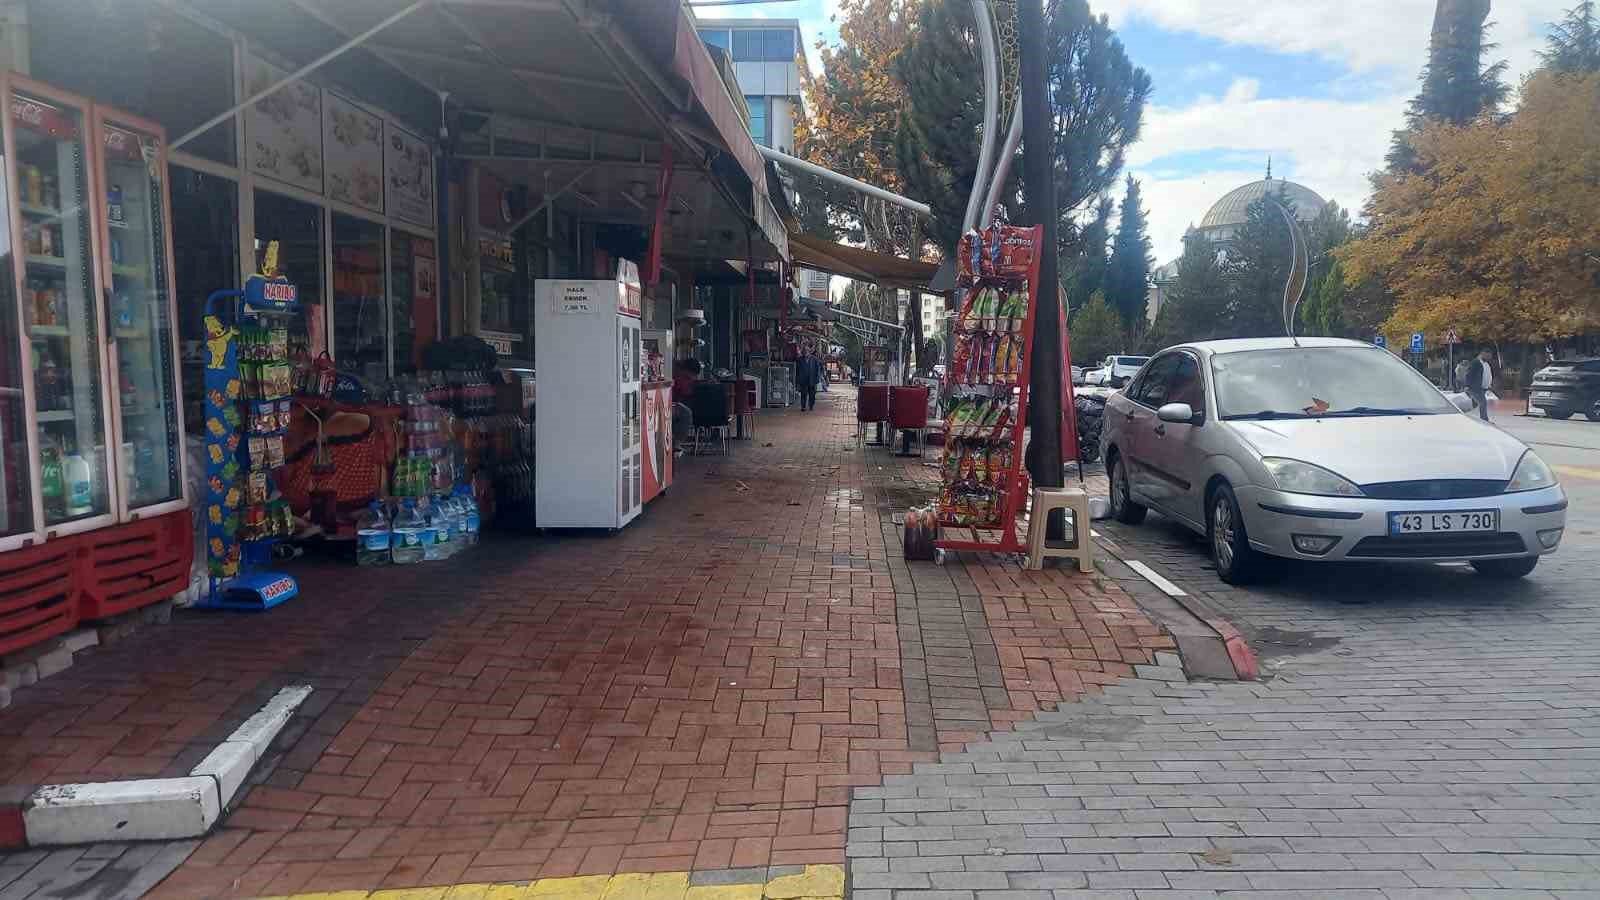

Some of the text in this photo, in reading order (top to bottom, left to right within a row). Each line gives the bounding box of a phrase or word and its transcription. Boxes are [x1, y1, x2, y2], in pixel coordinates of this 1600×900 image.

[264, 283, 296, 301] HARIBO
[1412, 334, 1421, 346] P
[1402, 513, 1491, 530] 43 LS 730
